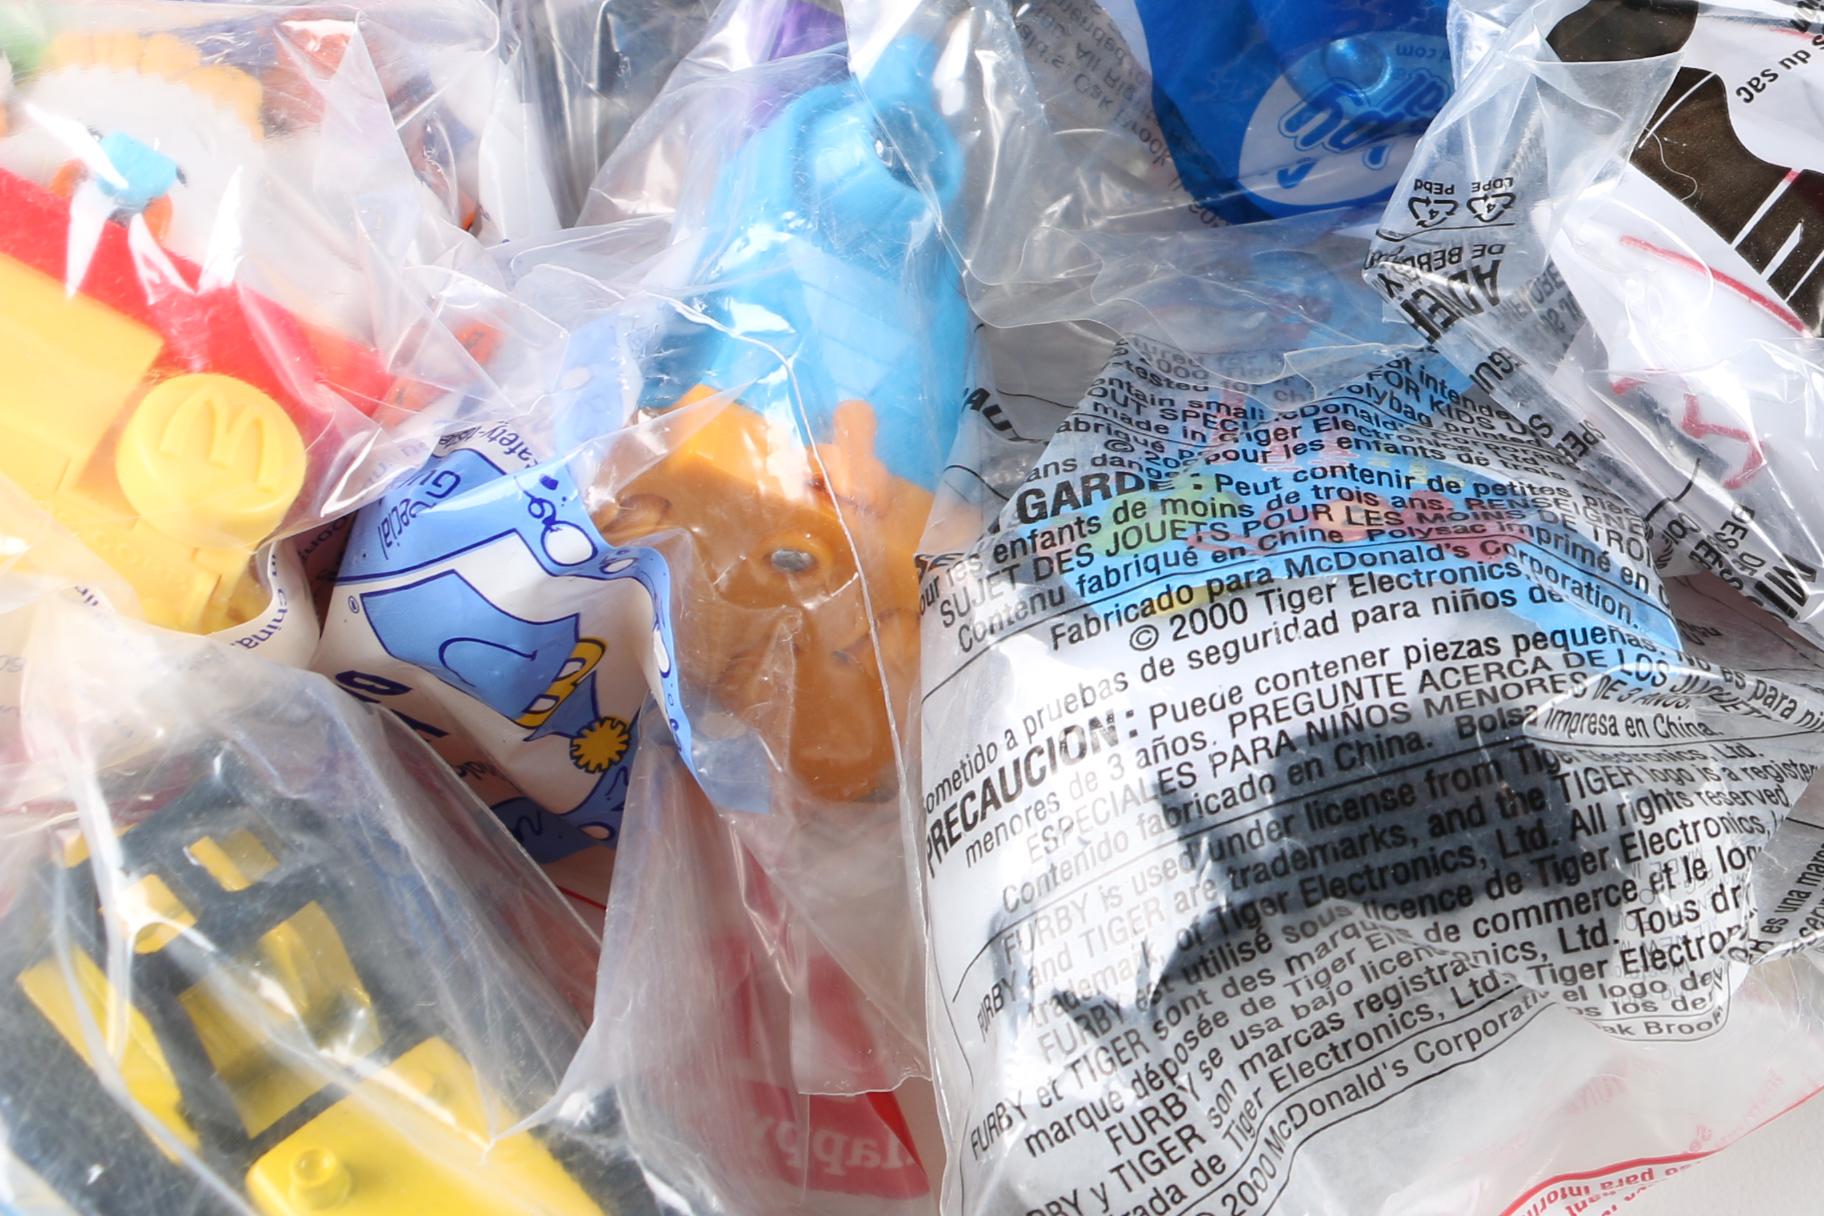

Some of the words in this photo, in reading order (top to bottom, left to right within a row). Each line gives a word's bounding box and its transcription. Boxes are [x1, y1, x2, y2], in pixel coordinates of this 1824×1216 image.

[1736, 67, 1779, 104] sac
[1778, 48, 1812, 71] du
[1214, 470, 1283, 497] Peut
[1292, 462, 1417, 492] contenir
[1427, 474, 1462, 495] de
[1283, 435, 1326, 459] les
[377, 497, 437, 561] pecial
[938, 563, 1021, 628] SUJET
[1033, 541, 1095, 582] DES
[1105, 518, 1231, 558] JOUETS
[1243, 503, 1335, 539] POUR
[1345, 504, 1405, 528] LES
[1538, 508, 1578, 534] DE
[992, 514, 1102, 565] enfants
[1112, 499, 1149, 526] de
[1161, 494, 1255, 519] moins
[1266, 489, 1301, 513] de
[1312, 483, 1381, 507] trois
[1391, 492, 1455, 512] ans.
[957, 585, 1067, 653] Contenu
[1076, 545, 1199, 598] fabriqué
[1211, 544, 1247, 564] en
[1257, 527, 1344, 552] Chine
[1619, 567, 1651, 596] en
[1050, 583, 1196, 652] Fabricado
[1205, 567, 1275, 604] para
[1284, 543, 1472, 581] McDonald's
[1169, 596, 1249, 642] 2000
[1256, 580, 1338, 617] Tiger
[1003, 728, 1019, 752] a
[1022, 670, 1130, 743] pruebas
[1140, 656, 1176, 684] de
[1187, 608, 1340, 671] seguridad
[1352, 600, 1421, 634] para
[1431, 584, 1518, 616] niños
[1254, 646, 1391, 697] contener
[1403, 635, 1501, 670] piezas
[1513, 623, 1668, 658] pequeñas.
[1750, 678, 1800, 723] para
[964, 790, 1061, 869] menores
[1068, 770, 1099, 802] de
[1106, 752, 1126, 782] 3
[1228, 670, 1407, 739] PREGUNTE
[1418, 654, 1551, 695] ACERCA
[1562, 649, 1609, 669] DE
[1617, 647, 1671, 688] LOS
[1001, 829, 1131, 915] Contenido
[1137, 770, 1278, 842] fabricado
[1287, 756, 1324, 786] en
[1333, 730, 1435, 773] China.
[1454, 702, 1540, 741] Bolsa
[1624, 717, 1651, 740] en
[1653, 712, 1726, 740] China.
[1026, 760, 1198, 865] ESPECIALES
[1209, 728, 1297, 779] PARA
[1304, 701, 1413, 748] NIÑOS
[1423, 672, 1589, 719] MENORES
[1130, 841, 1199, 895] used
[1208, 813, 1297, 864] under
[1303, 783, 1418, 832] license
[1424, 756, 1504, 801] from
[1171, 877, 1217, 915] are
[1227, 821, 1418, 893] trademarks,
[1428, 794, 1487, 837] and
[1496, 783, 1547, 820] the
[1552, 765, 1643, 805] TIGER
[1645, 761, 1695, 787] logo
[1700, 758, 1721, 783] is
[1298, 843, 1488, 911] Electronics,
[1496, 820, 1560, 861] Ltd.
[1569, 800, 1609, 843] All
[1617, 786, 1695, 826] rights
[1036, 998, 1126, 1065] FURBY
[1183, 925, 1273, 986] utilisé
[1281, 901, 1353, 945] sous
[1360, 881, 1476, 923] licence
[1483, 867, 1525, 902] de
[1530, 846, 1610, 889] Tiger
[1619, 811, 1773, 865] Electronics,
[1774, 888, 1812, 916] una
[970, 1088, 1029, 1162] FURBY
[1063, 1027, 1152, 1091] TIGER
[1152, 983, 1214, 1041] sont
[1221, 966, 1276, 1000] des
[1423, 921, 1462, 944] de
[1473, 877, 1639, 939] commerce
[1024, 1089, 1125, 1159] marque
[1131, 1009, 1231, 1101] déposée
[1240, 994, 1277, 1018] de
[1283, 947, 1357, 999] Tiger
[1557, 917, 1621, 957] Ltd.
[1627, 897, 1702, 938] Tous
[1105, 1071, 1202, 1158] FURBY
[1199, 1045, 1224, 1082] se
[1229, 1014, 1285, 1051] usa
[1290, 978, 1355, 1022] bajo
[1527, 957, 1610, 986] Tiger
[1190, 1153, 1228, 1189] de
[1222, 1086, 1265, 1153] Tiger
[1268, 1002, 1446, 1094] Electronics,
[1450, 968, 1512, 1010] Ltd.
[1109, 1122, 1208, 1194] TIGER
[1207, 1077, 1239, 1130] son
[1238, 1009, 1346, 1082] marcas
[1263, 1057, 1410, 1162] McDonald's
